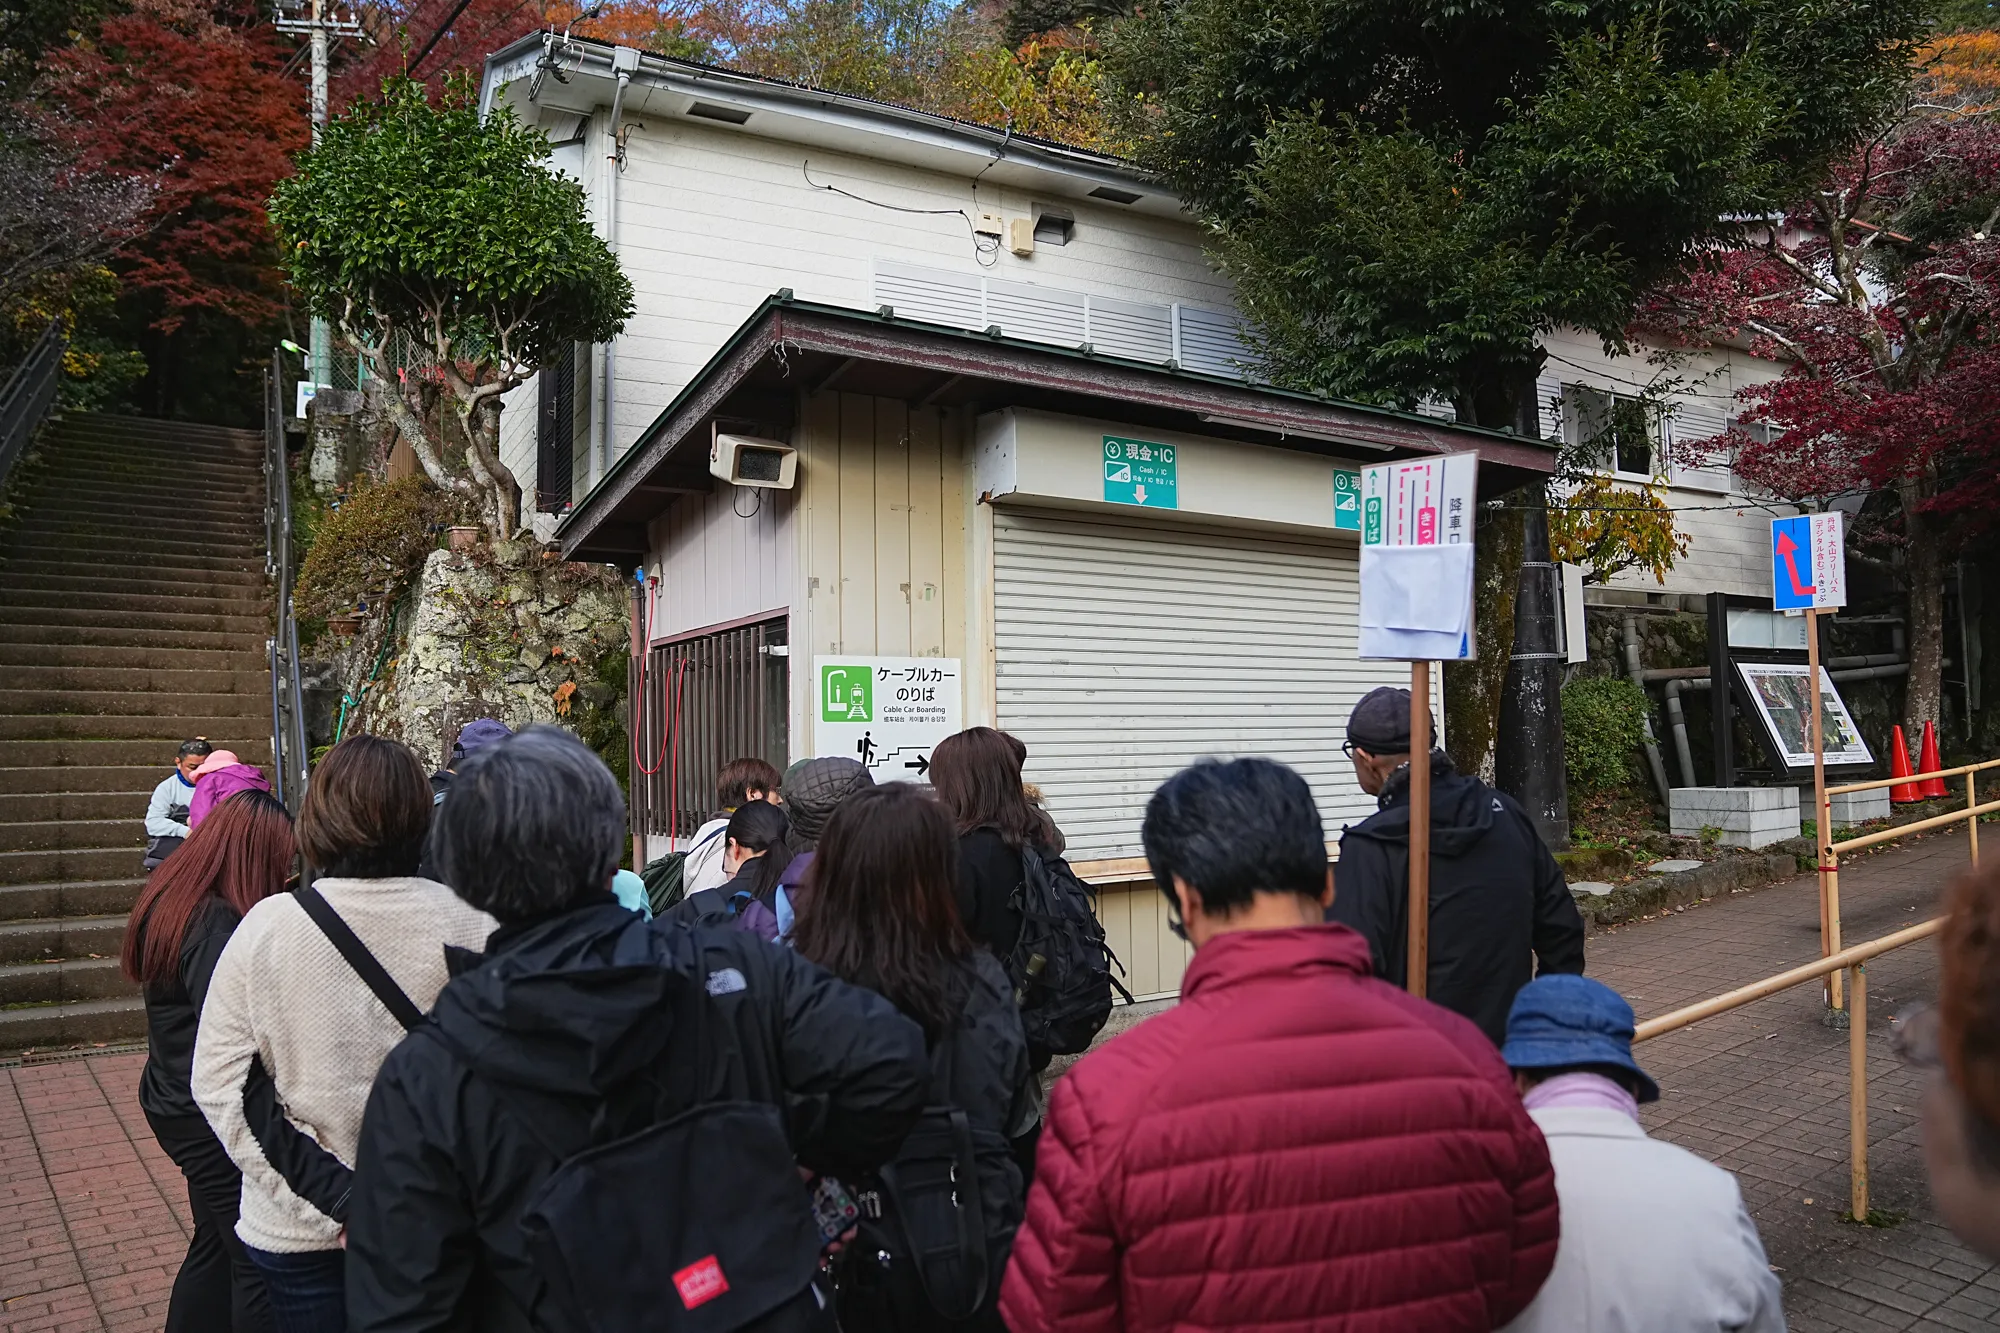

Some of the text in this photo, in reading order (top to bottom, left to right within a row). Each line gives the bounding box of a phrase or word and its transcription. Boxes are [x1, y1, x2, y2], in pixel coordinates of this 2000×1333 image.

[1139, 466, 1154, 474] Cash
[1367, 500, 1379, 543] のりば
[1448, 498, 1462, 544] 降車口
[877, 666, 956, 682] ケーブルカー
[896, 687, 936, 701] のりば
[883, 705, 946, 714] Cable Car Boarding
